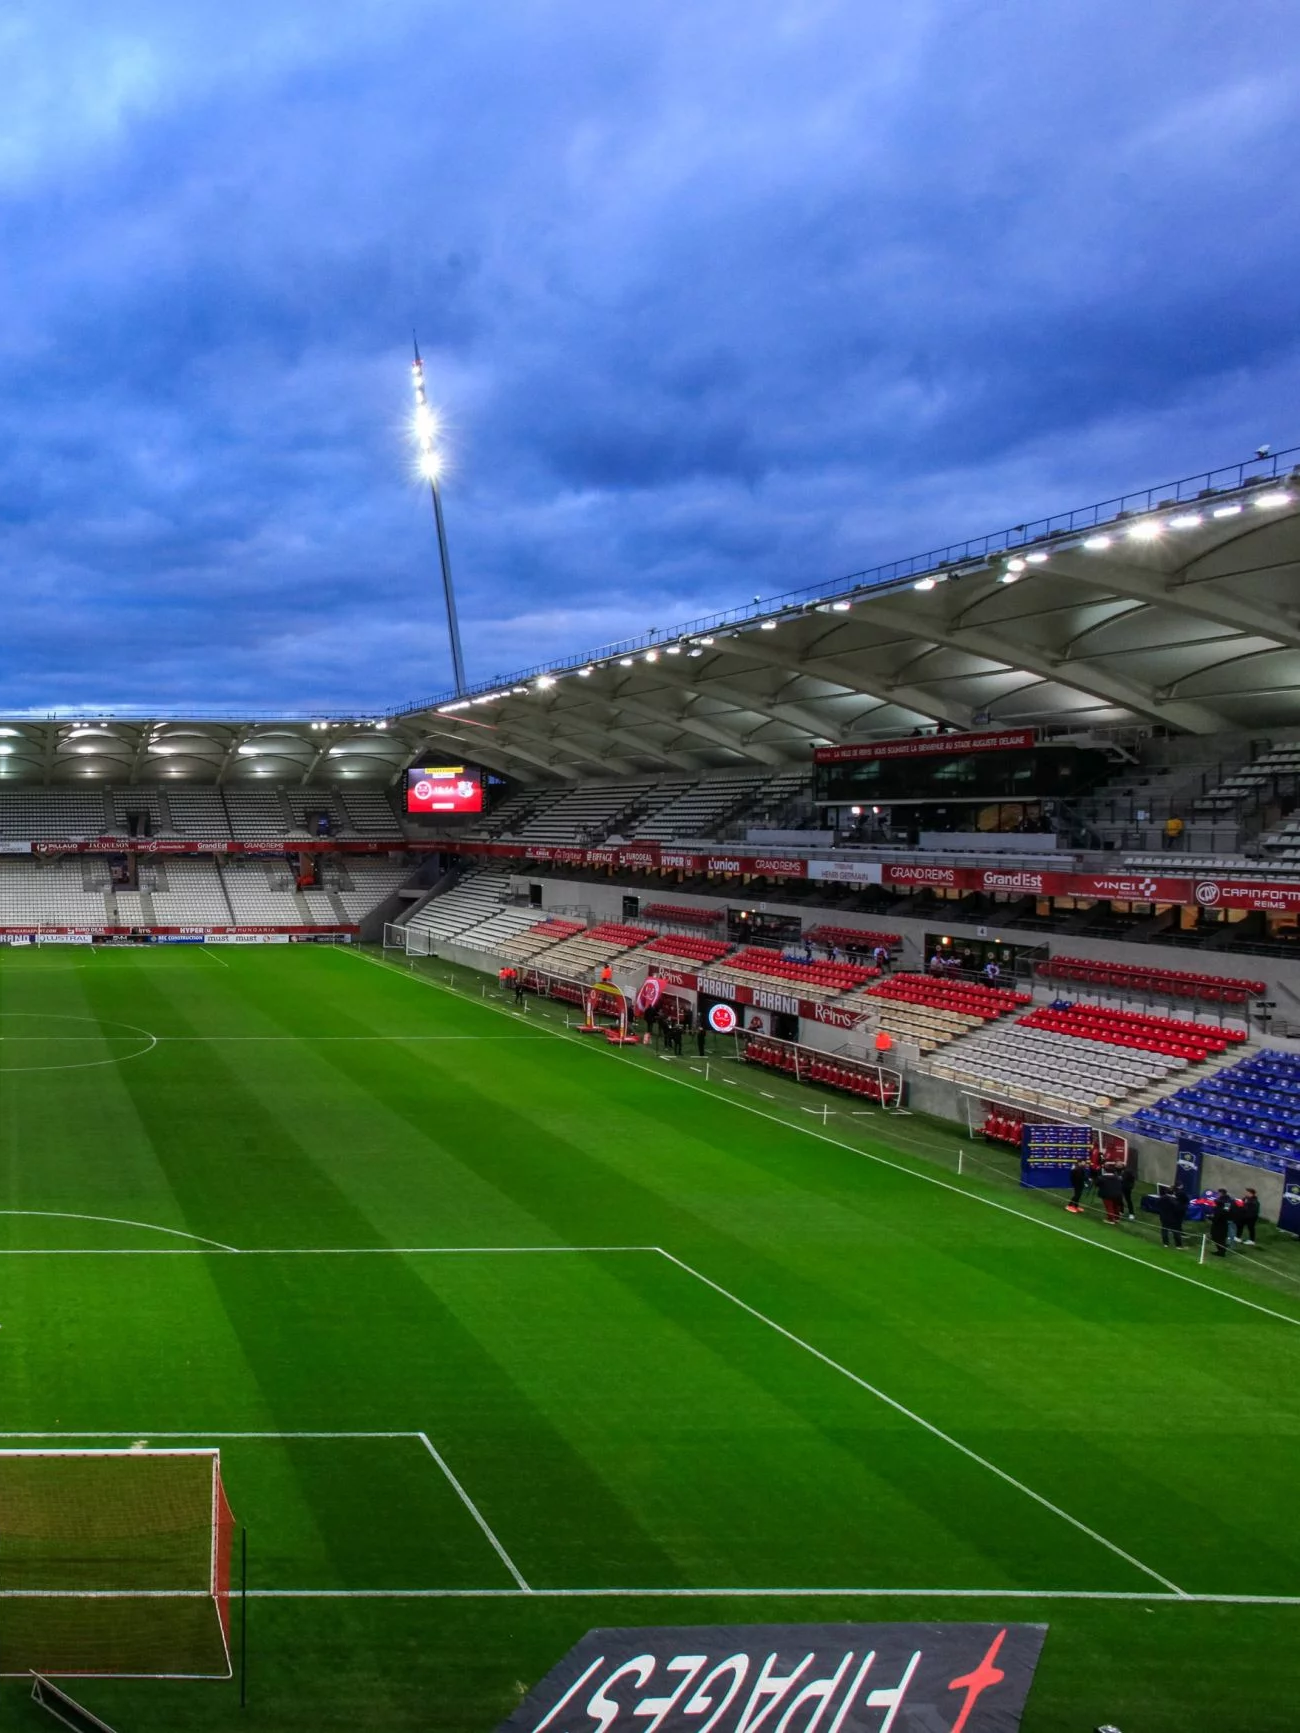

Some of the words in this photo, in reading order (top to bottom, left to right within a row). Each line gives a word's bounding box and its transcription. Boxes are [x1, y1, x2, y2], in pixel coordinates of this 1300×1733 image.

[592, 852, 613, 862] EIFFAGE
[661, 855, 684, 866] HYPER
[708, 857, 740, 871] L'union
[755, 860, 781, 870] GRAND
[890, 867, 924, 879] GRAND
[925, 869, 954, 881] REIMS
[983, 871, 1020, 885] Grand
[1022, 873, 1042, 887] Est
[1094, 881, 1136, 891] VINCI
[1254, 900, 1286, 909] REIMS
[697, 976, 736, 1000] PARANO
[753, 989, 799, 1015] PARANO
[814, 1003, 851, 1027] Reims
